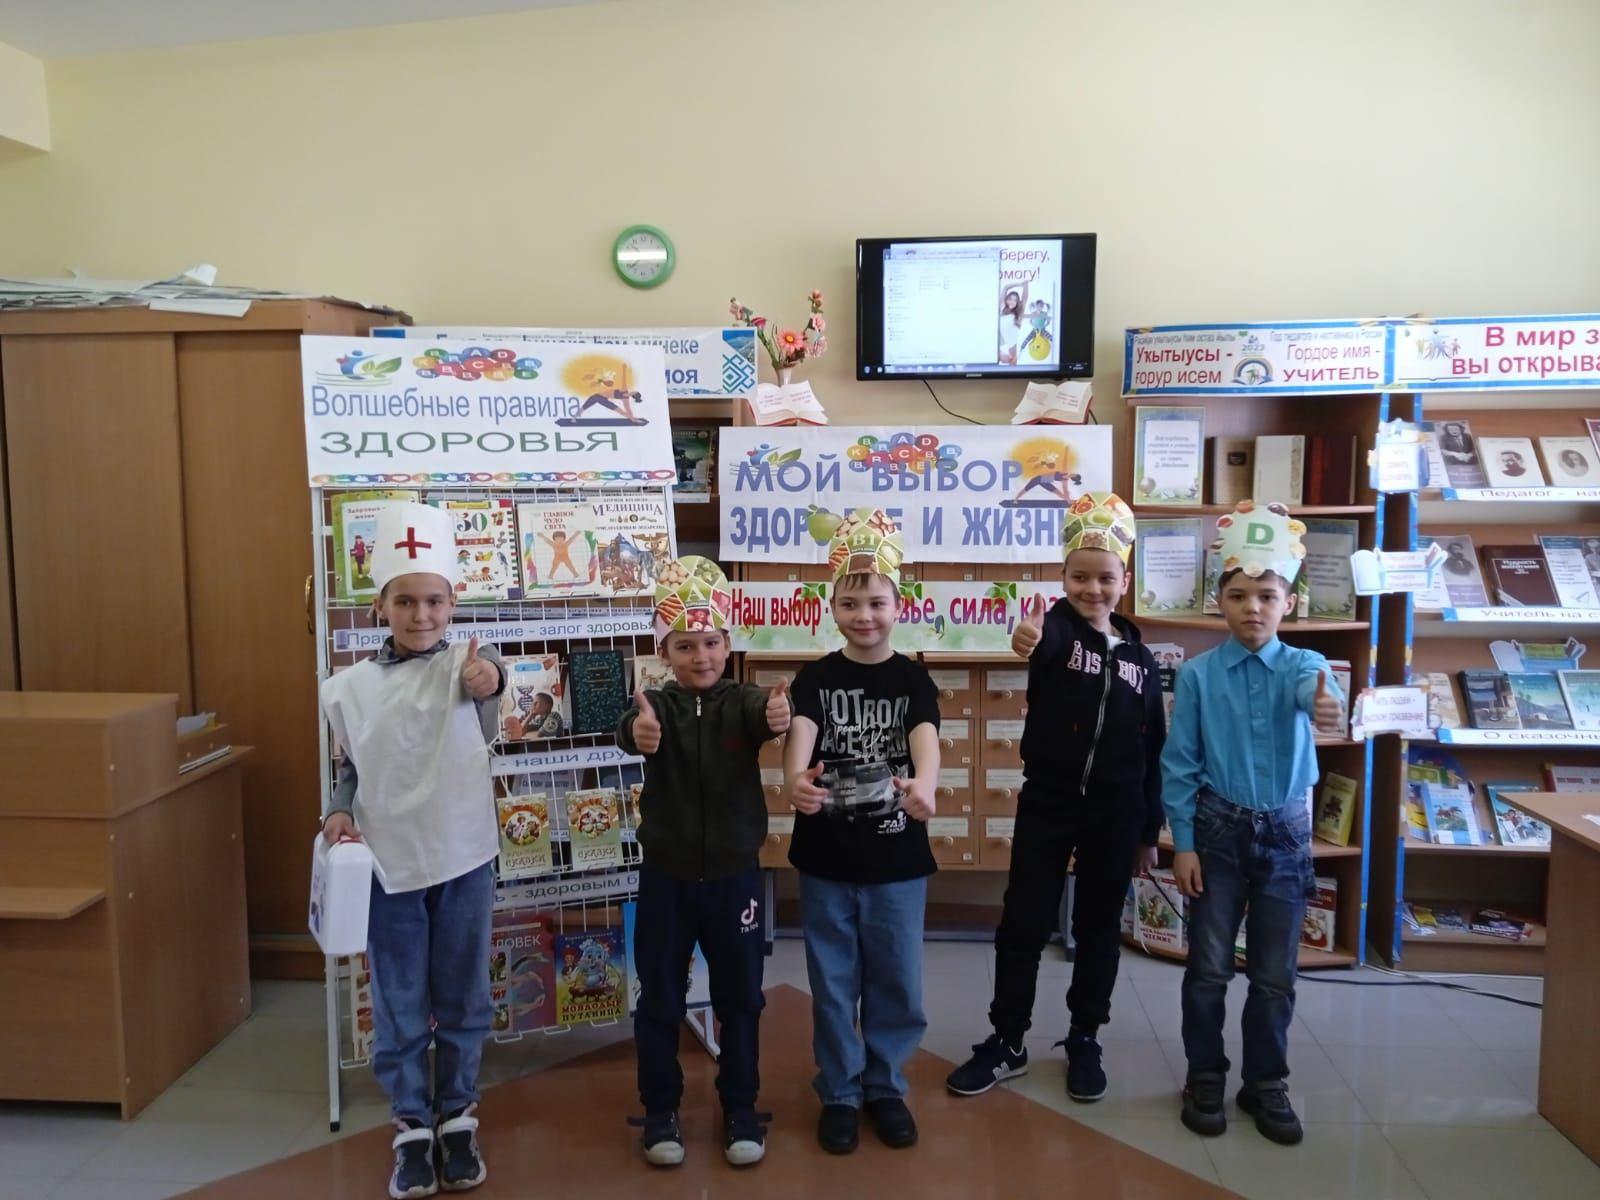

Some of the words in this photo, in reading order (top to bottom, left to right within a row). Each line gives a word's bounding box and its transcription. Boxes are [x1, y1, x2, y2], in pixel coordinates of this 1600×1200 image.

[1484, 326, 1505, 347] В
[1516, 329, 1576, 351] мир
[1287, 344, 1338, 363] Гордое
[1343, 345, 1371, 359] имя
[1178, 370, 1222, 384] исем
[1283, 367, 1380, 382] УЧИТЕЛЬ
[311, 386, 470, 418] Волшебные
[480, 394, 581, 424] правила
[320, 431, 619, 458] ЗДОРОВЬЯ
[735, 453, 841, 492] МОЙ
[872, 459, 1022, 492] ВЫБОР
[923, 506, 943, 546] И
[1246, 523, 1275, 545] D
[731, 588, 765, 626] Наш
[771, 588, 821, 635] выбор
[949, 596, 1015, 635] сила,
[458, 626, 524, 641] питание
[539, 623, 583, 636] залог
[515, 754, 579, 768] наши
[525, 877, 620, 899] здоровым
